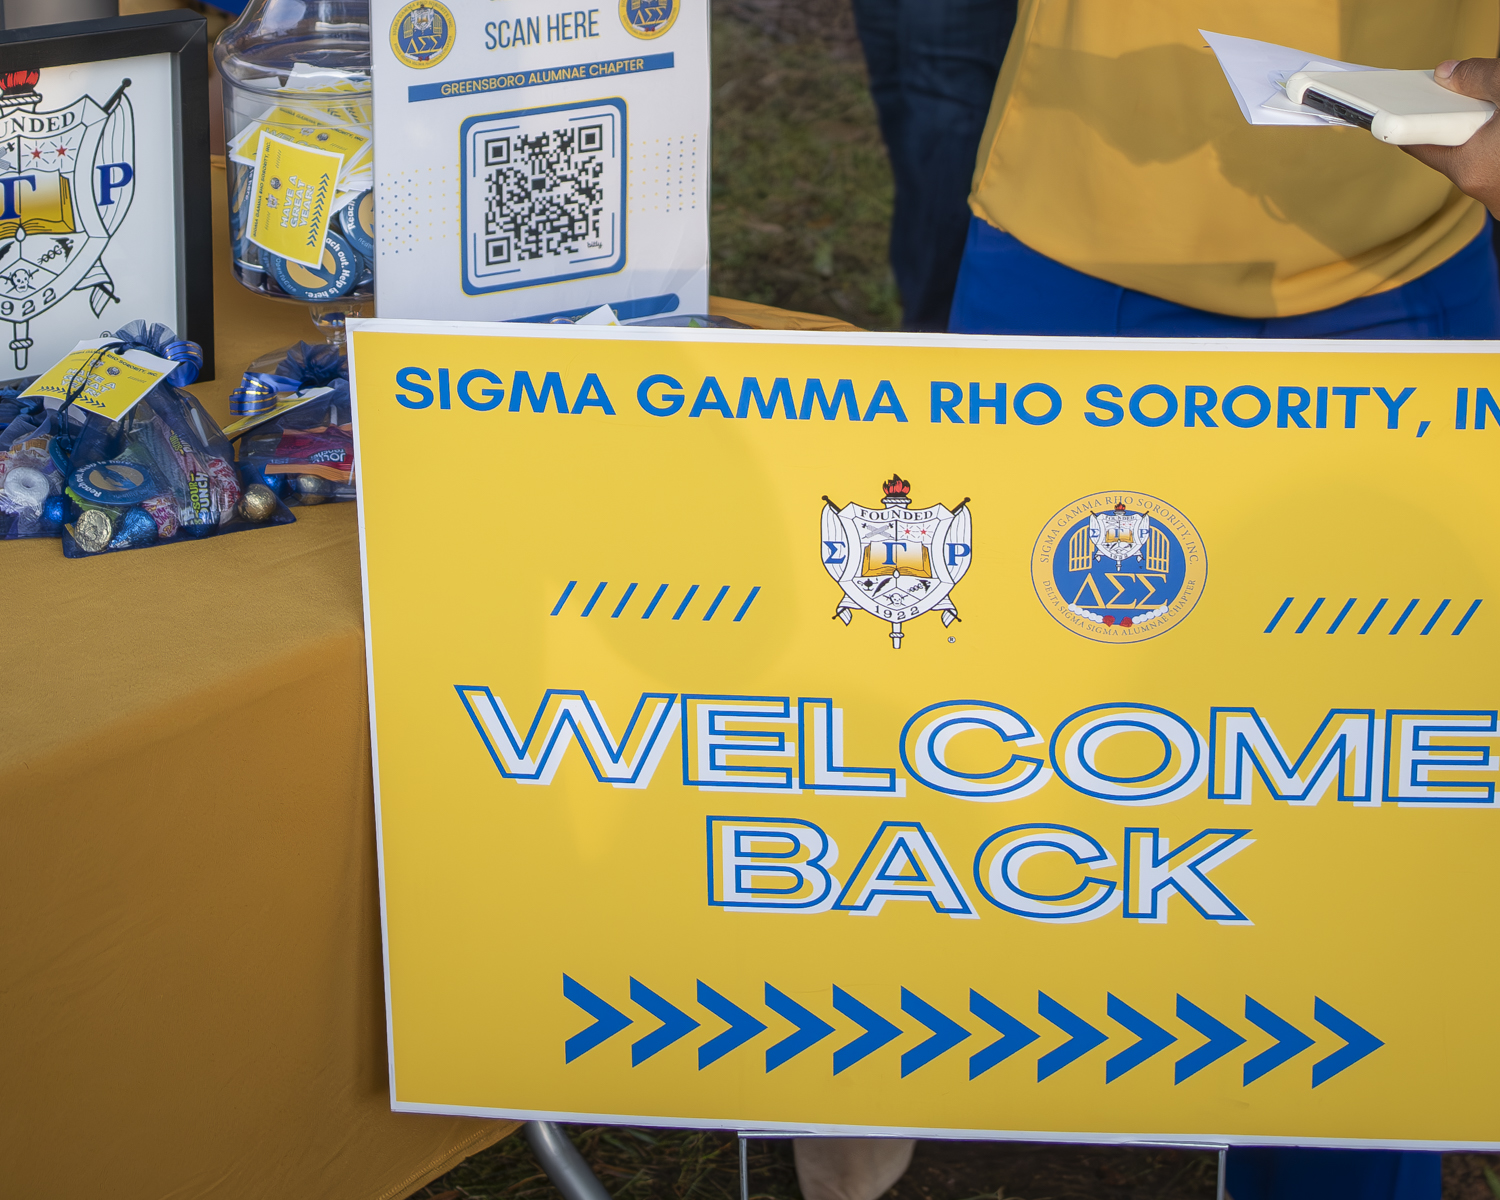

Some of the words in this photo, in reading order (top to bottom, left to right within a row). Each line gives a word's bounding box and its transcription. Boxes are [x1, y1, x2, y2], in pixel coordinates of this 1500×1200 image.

[485, 16, 541, 51] SCAN
[547, 9, 600, 43] HERE
[440, 74, 526, 96] GREENSBORO
[528, 65, 586, 85] ALUMNAE
[589, 58, 645, 76] CHAPTER
[280, 188, 295, 228] HAVE
[289, 175, 298, 185] A
[289, 180, 306, 228] GREAT
[299, 185, 315, 227] YEAR!
[325, 237, 340, 252] ach
[338, 251, 350, 268] out.
[335, 269, 351, 288] Help
[305, 290, 329, 298] here.
[329, 287, 339, 295] is
[63, 374, 110, 393] GREAT
[66, 368, 105, 384] HAVE
[396, 367, 615, 415] SIGMA
[637, 375, 908, 422] GAMMA
[931, 382, 1062, 425] RHO
[1085, 384, 1430, 437] SORORITY,
[78, 482, 102, 498] Reach
[188, 482, 200, 510] SOUR
[860, 509, 933, 521] FOUNDED
[1040, 528, 1060, 563] SIGMA
[1057, 500, 1102, 527] GAMMA
[1105, 495, 1133, 505] RHO
[1136, 498, 1191, 540] SORORITY,
[1186, 541, 1199, 565] INC.
[874, 605, 920, 620] 1922
[1042, 580, 1059, 607] DELTA
[1058, 606, 1085, 629] SIGMA
[1086, 624, 1119, 636] SIGMA
[1121, 616, 1169, 636] ALUMNAE
[1169, 580, 1196, 617] CHAPTER
[706, 815, 1255, 926] BACK
